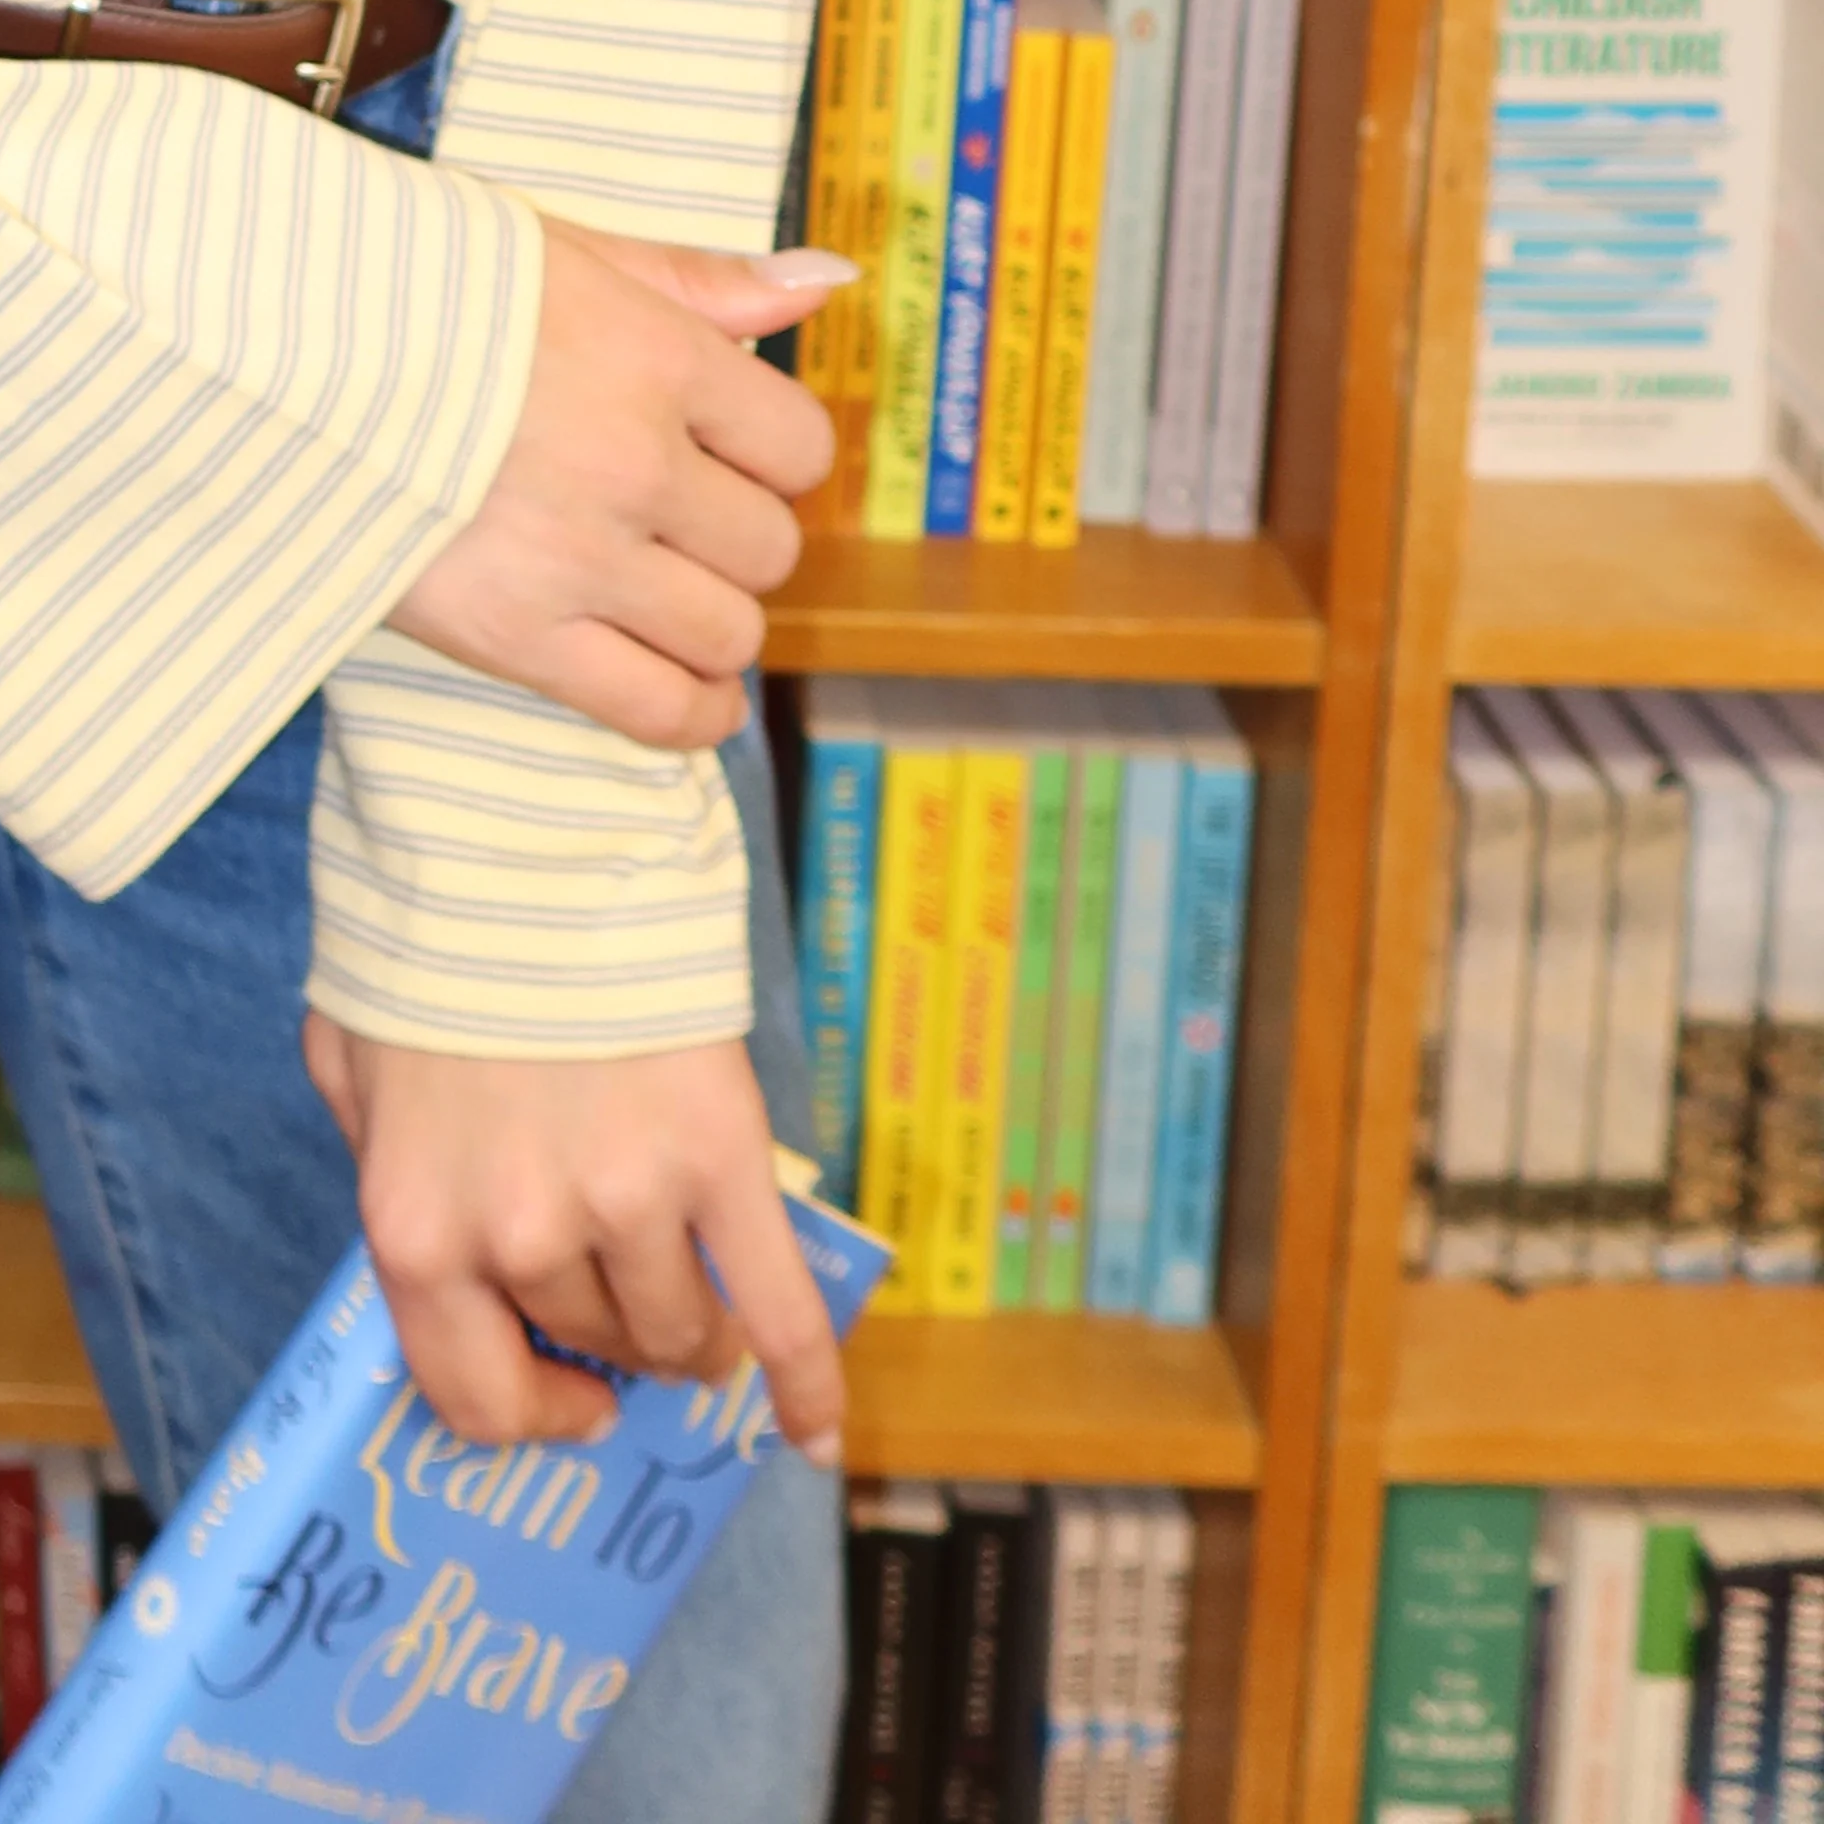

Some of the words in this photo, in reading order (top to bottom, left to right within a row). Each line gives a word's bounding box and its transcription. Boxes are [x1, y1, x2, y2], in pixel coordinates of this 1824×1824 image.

[1496, 30, 1725, 79] ITERATURE
[358, 1380, 602, 1567] Learn
[191, 1509, 385, 1699] Be
[335, 1561, 630, 1746] Brave
